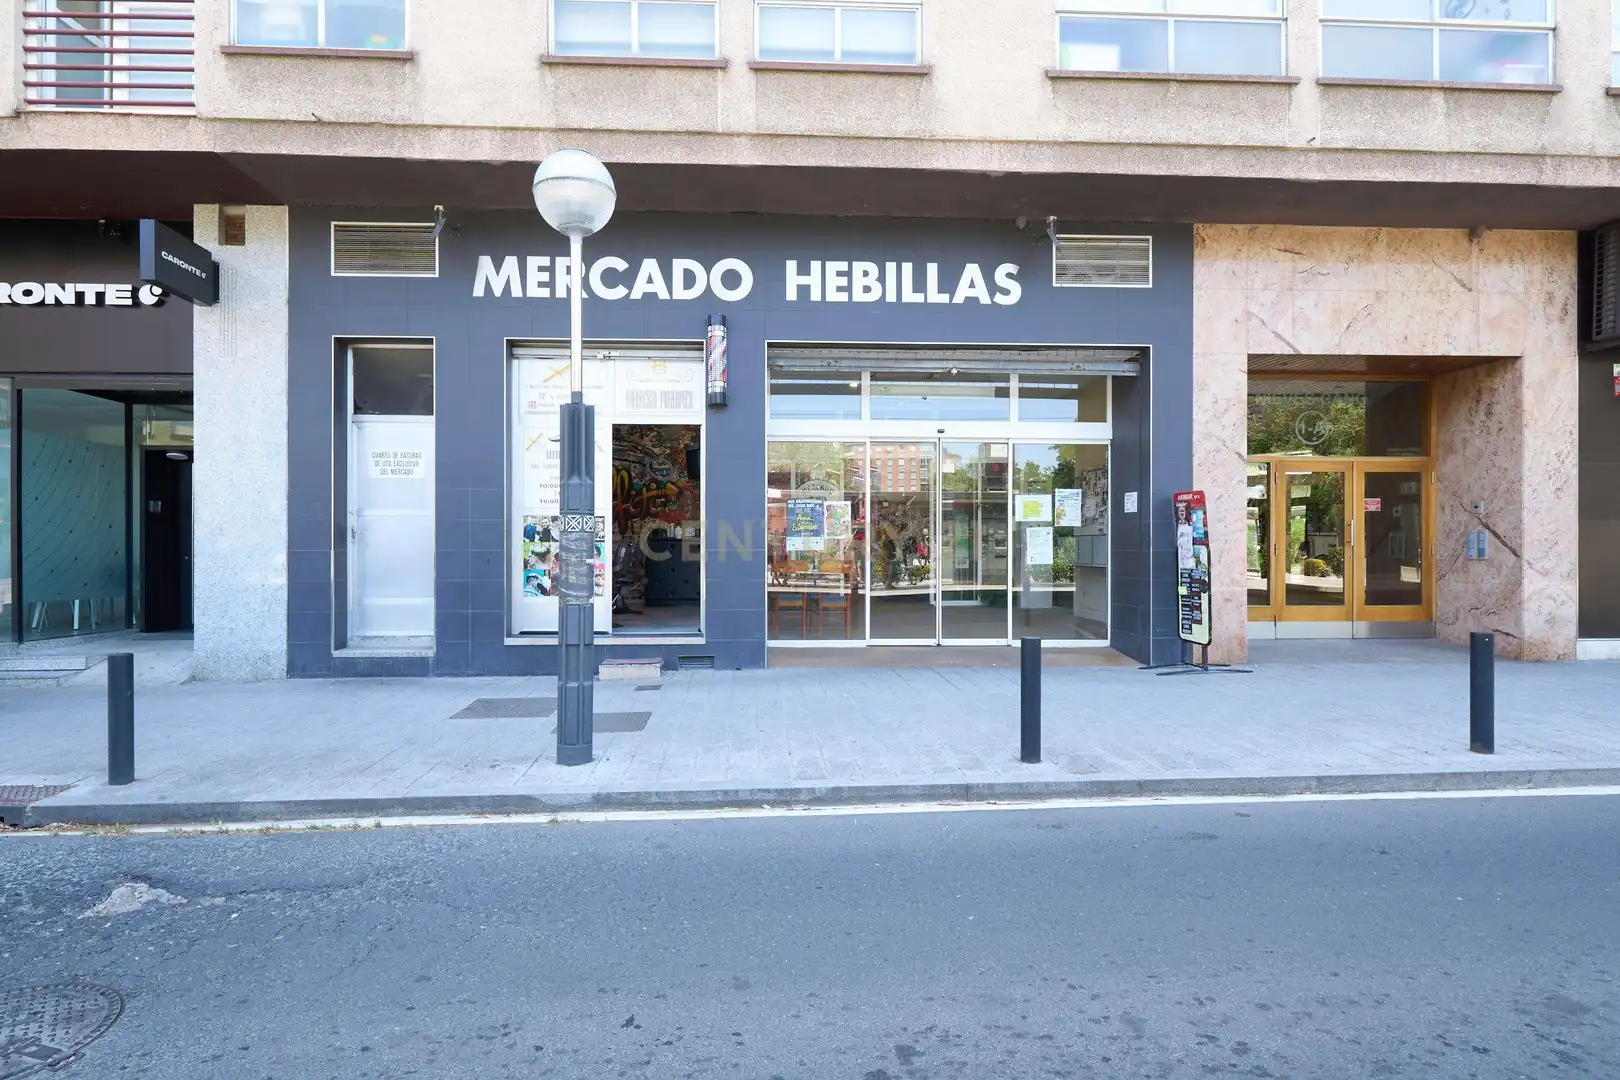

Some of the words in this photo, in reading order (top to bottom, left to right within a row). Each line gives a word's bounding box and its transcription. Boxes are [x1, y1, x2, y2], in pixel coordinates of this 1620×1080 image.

[161, 251, 202, 277] CARONTE
[472, 255, 754, 301] MERCADO
[785, 259, 1022, 305] HEBILLAS
[371, 451, 391, 459] CUARTO
[392, 451, 399, 459] DE
[400, 451, 422, 459] BASURAS
